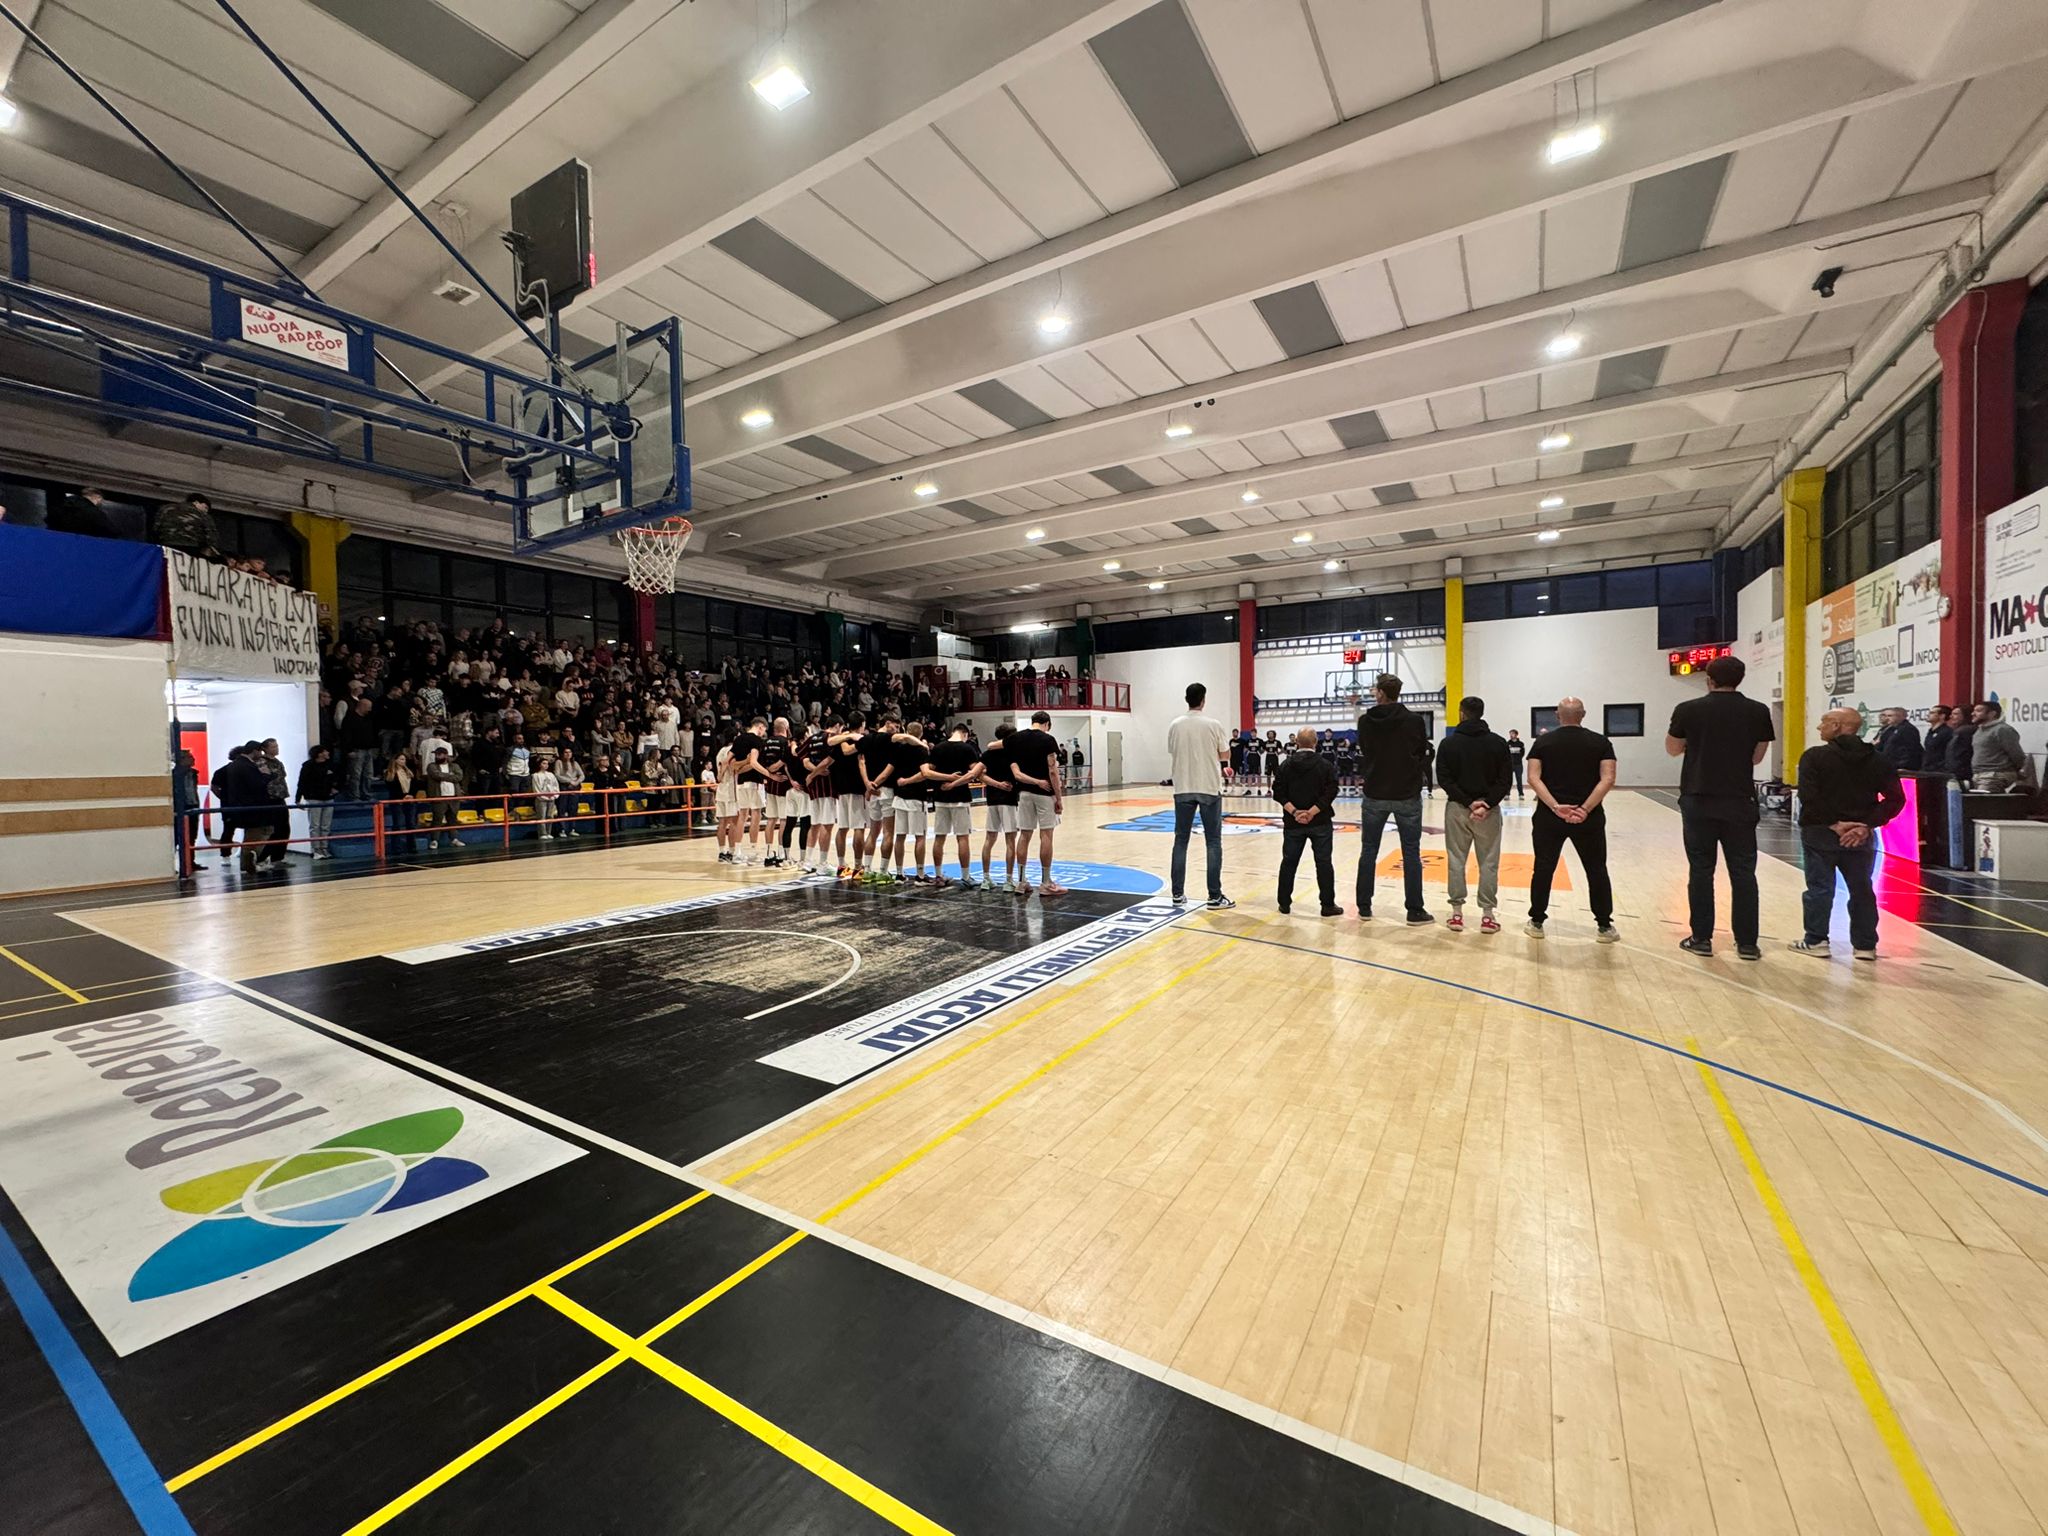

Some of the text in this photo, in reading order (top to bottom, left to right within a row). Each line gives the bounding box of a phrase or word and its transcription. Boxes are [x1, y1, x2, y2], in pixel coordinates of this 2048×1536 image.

[246, 321, 300, 336] NUOVA
[277, 330, 325, 344] RADAR
[306, 338, 343, 352] COOP
[172, 550, 278, 619] GALLARATE
[176, 605, 188, 640] E
[189, 606, 236, 648] VINCI
[238, 615, 300, 655] INSIEME
[1344, 650, 1361, 663] 24
[1690, 648, 1716, 661] 5:29
[462, 921, 603, 951] ACCIAI
[990, 927, 1144, 991] BETTINELLI
[824, 1021, 866, 1039] TUBES
[857, 989, 1009, 1053] ACCIAI
[16, 1013, 329, 1170] Renexia
